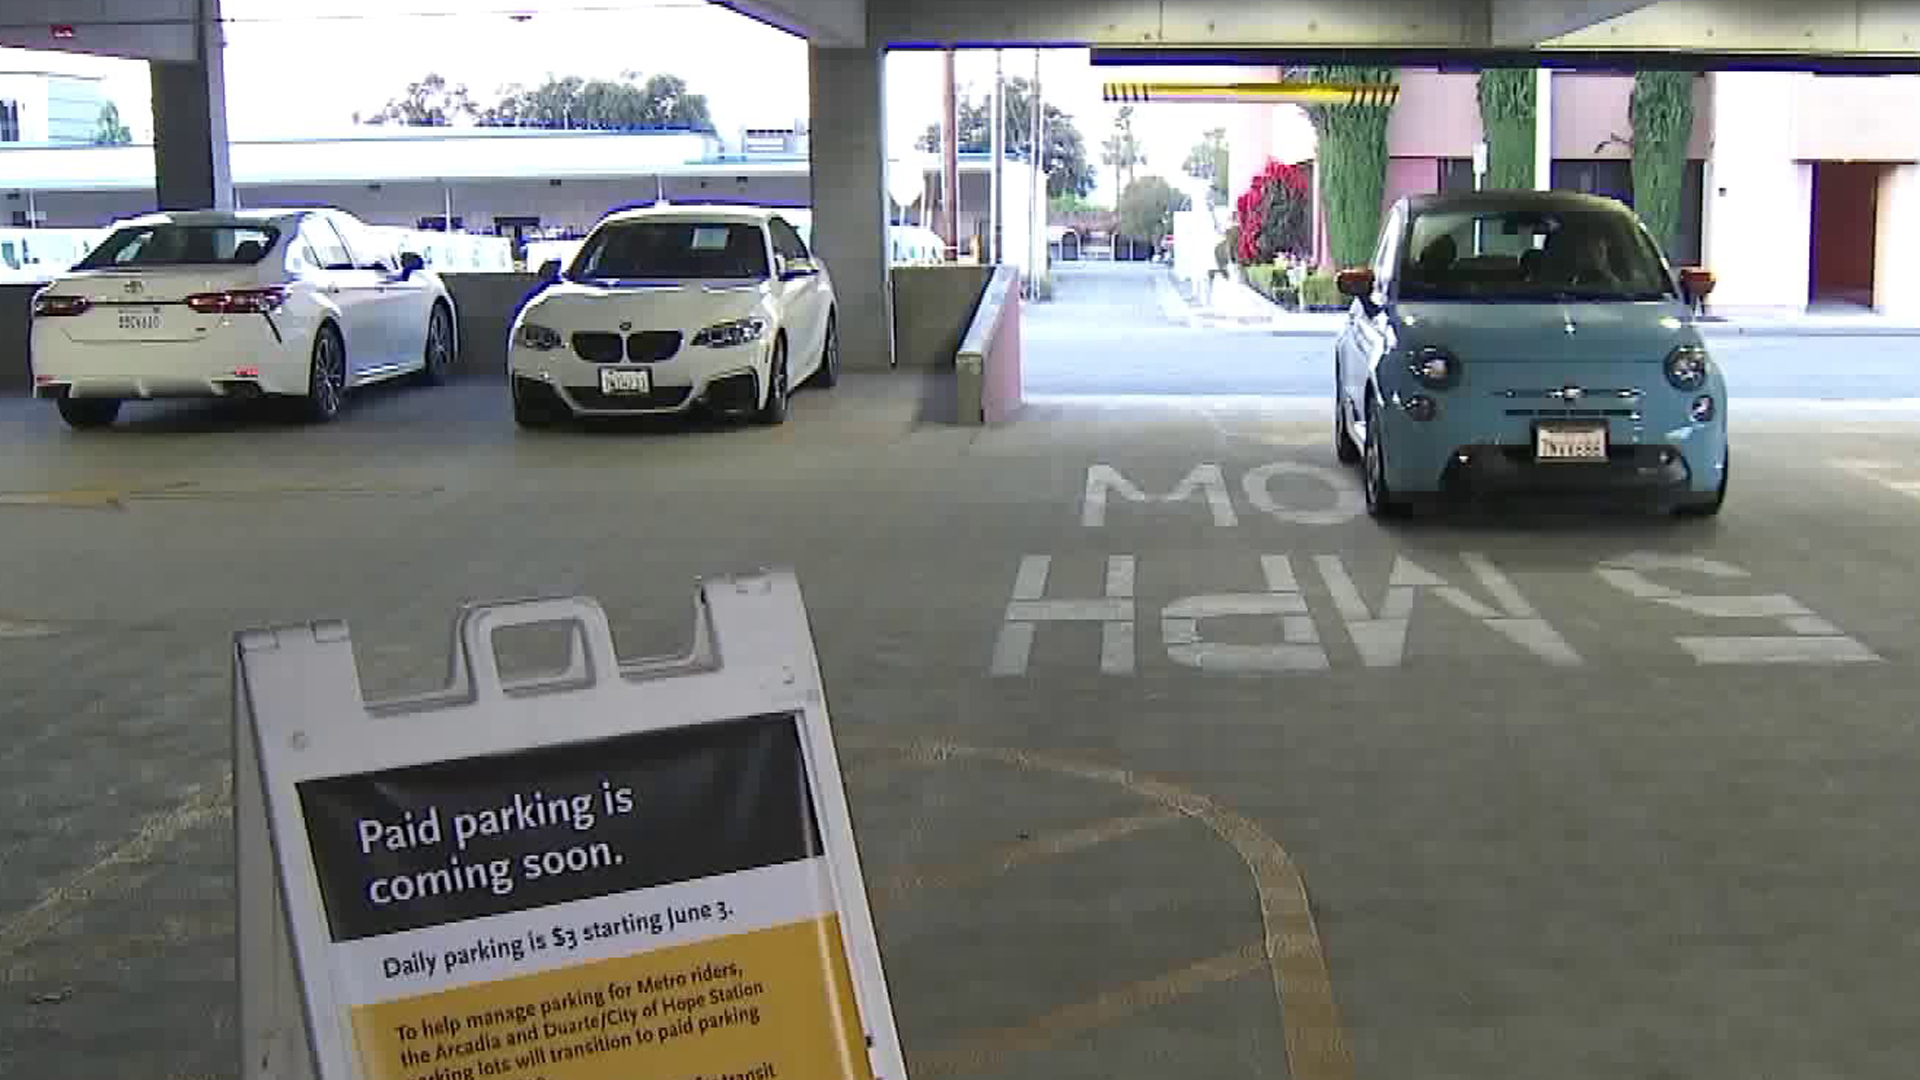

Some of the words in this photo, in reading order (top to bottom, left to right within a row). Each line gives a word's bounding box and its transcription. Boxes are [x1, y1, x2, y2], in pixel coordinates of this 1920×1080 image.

[1083, 462, 1365, 527] OW
[990, 554, 1584, 675] MPH
[1599, 551, 1881, 664] 5
[358, 806, 441, 853] Paid
[454, 791, 595, 850] parking
[602, 780, 633, 815] is
[369, 856, 513, 903] coming
[522, 842, 623, 879] soon.
[383, 952, 436, 979] Daily
[444, 936, 525, 973] parking
[529, 930, 546, 950] is
[552, 926, 578, 949] $3
[583, 911, 663, 941] starting
[667, 904, 711, 931] June
[716, 901, 734, 921] 3.
[397, 1025, 417, 1041] To
[422, 1015, 461, 1037] help
[467, 1003, 536, 1029] manage
[541, 988, 605, 1018] parking
[608, 981, 631, 1000] for
[637, 974, 686, 994] Metro
[691, 962, 742, 983] riders,
[401, 1048, 430, 1068] the
[436, 1034, 501, 1062] Arcadia
[507, 1023, 538, 1046] and
[543, 1008, 637, 1039] Duarte/City
[642, 999, 657, 1018] of
[663, 995, 704, 1017] Hope
[710, 980, 763, 1005] Station
[408, 1067, 475, 1080] arking
[478, 1060, 511, 1076] lots
[515, 1048, 546, 1070] will
[551, 1032, 631, 1064] transition
[636, 1028, 653, 1045] to
[659, 1016, 693, 1044] paid
[699, 1005, 760, 1035] parking
